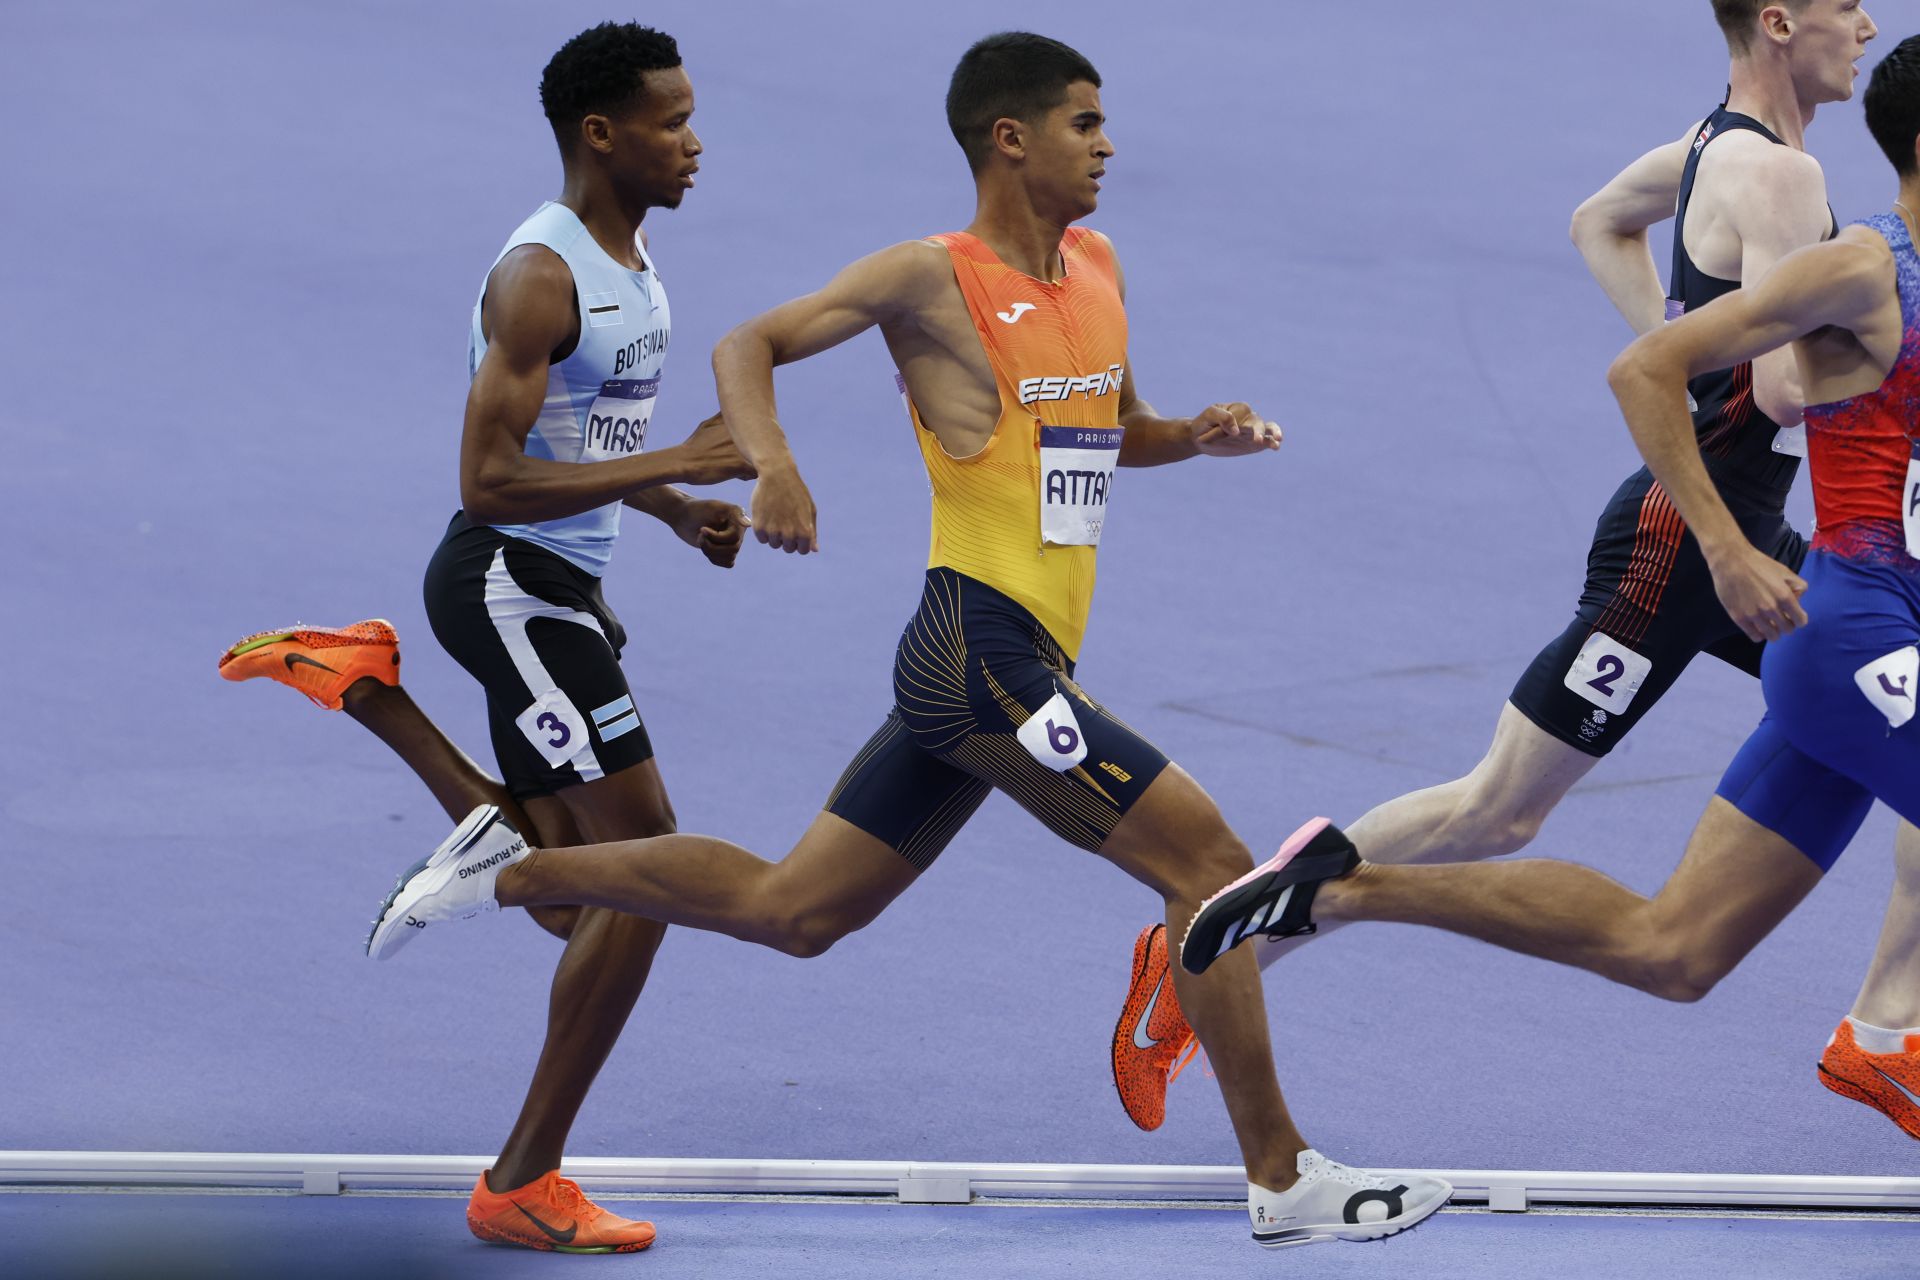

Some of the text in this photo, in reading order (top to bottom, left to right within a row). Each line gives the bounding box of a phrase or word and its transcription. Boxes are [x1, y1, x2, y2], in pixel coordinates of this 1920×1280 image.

[1077, 433, 1107, 444] PARIS
[1586, 654, 1625, 698] 2
[536, 711, 571, 749] 3
[1045, 717, 1079, 755] 6
[458, 848, 511, 880] RUNNING
